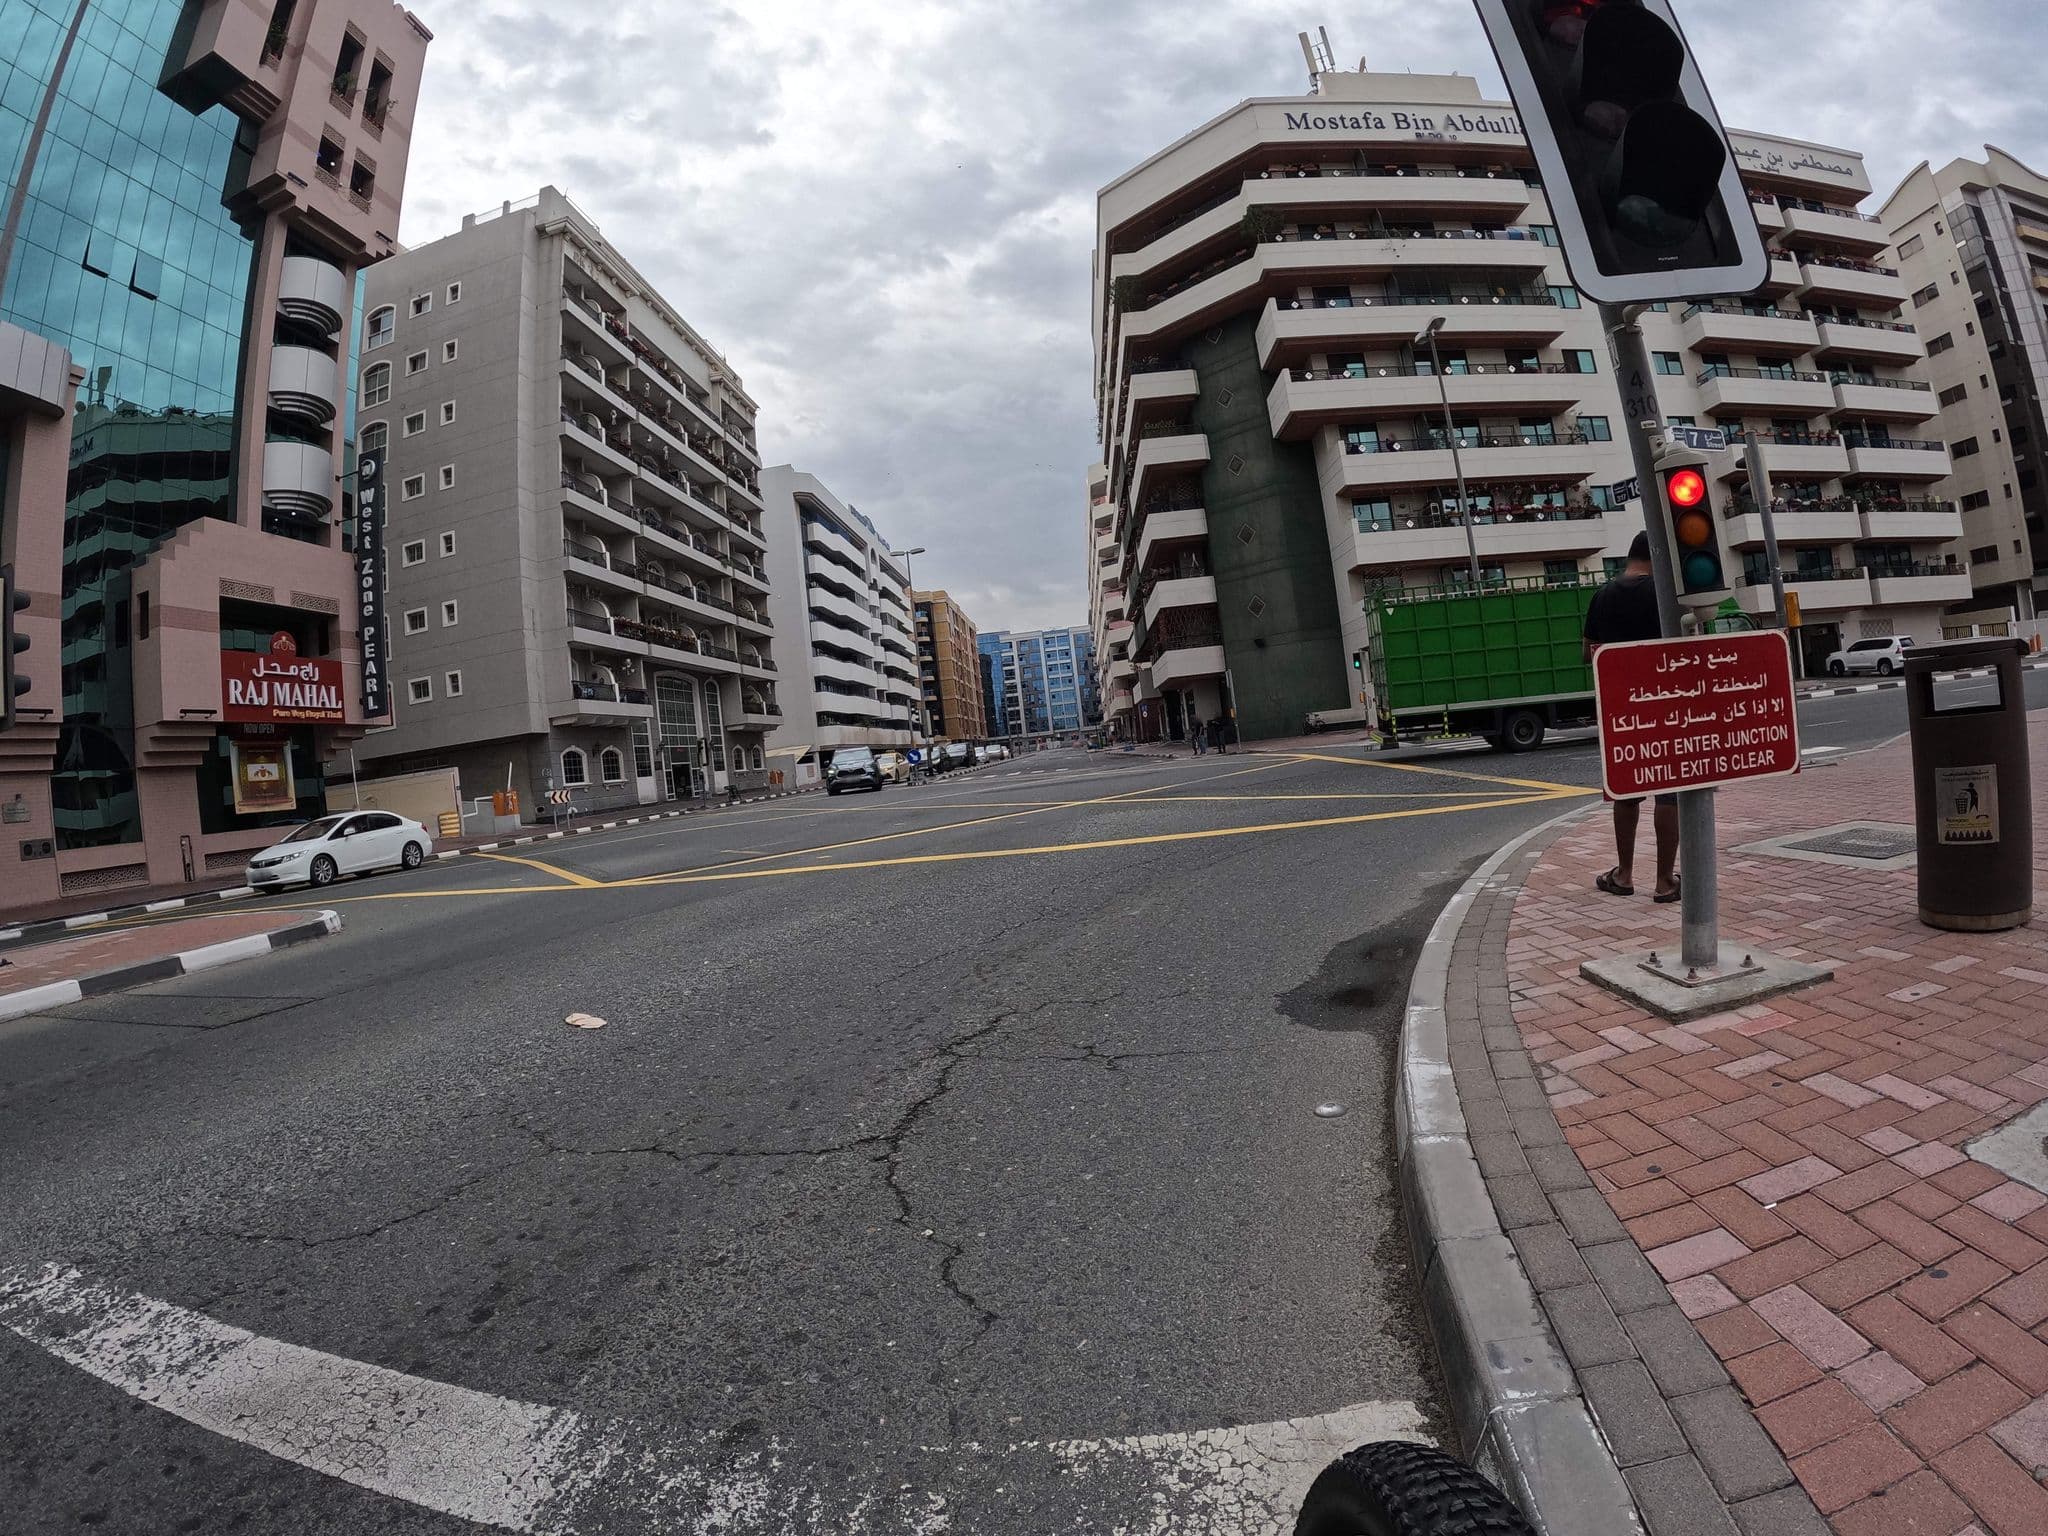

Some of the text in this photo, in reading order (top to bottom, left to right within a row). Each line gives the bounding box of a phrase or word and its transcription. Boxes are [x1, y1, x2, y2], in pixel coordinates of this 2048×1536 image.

[1284, 112, 1525, 135] Mostafa Bin Abdull
[1767, 152, 1783, 166] بن
[1789, 153, 1853, 177] مصطفى
[1626, 395, 1658, 418] 310
[1689, 431, 1698, 447] 7
[360, 488, 379, 710] West Zone PEARL
[252, 657, 319, 681] راج محل
[1656, 648, 1738, 673] يمنع دخول
[228, 679, 343, 709] RAJ MAHAL
[1628, 673, 1768, 703] المنطقة المخططة
[1722, 701, 1747, 723] كان
[1752, 699, 1768, 719] إذا
[1771, 697, 1785, 716] إلا
[1664, 708, 1717, 729] مسارك
[1613, 724, 1789, 764] DO NOT ENTER JUNCTION
[1633, 749, 1776, 785] UNTIL EXIT IS CLEAR
